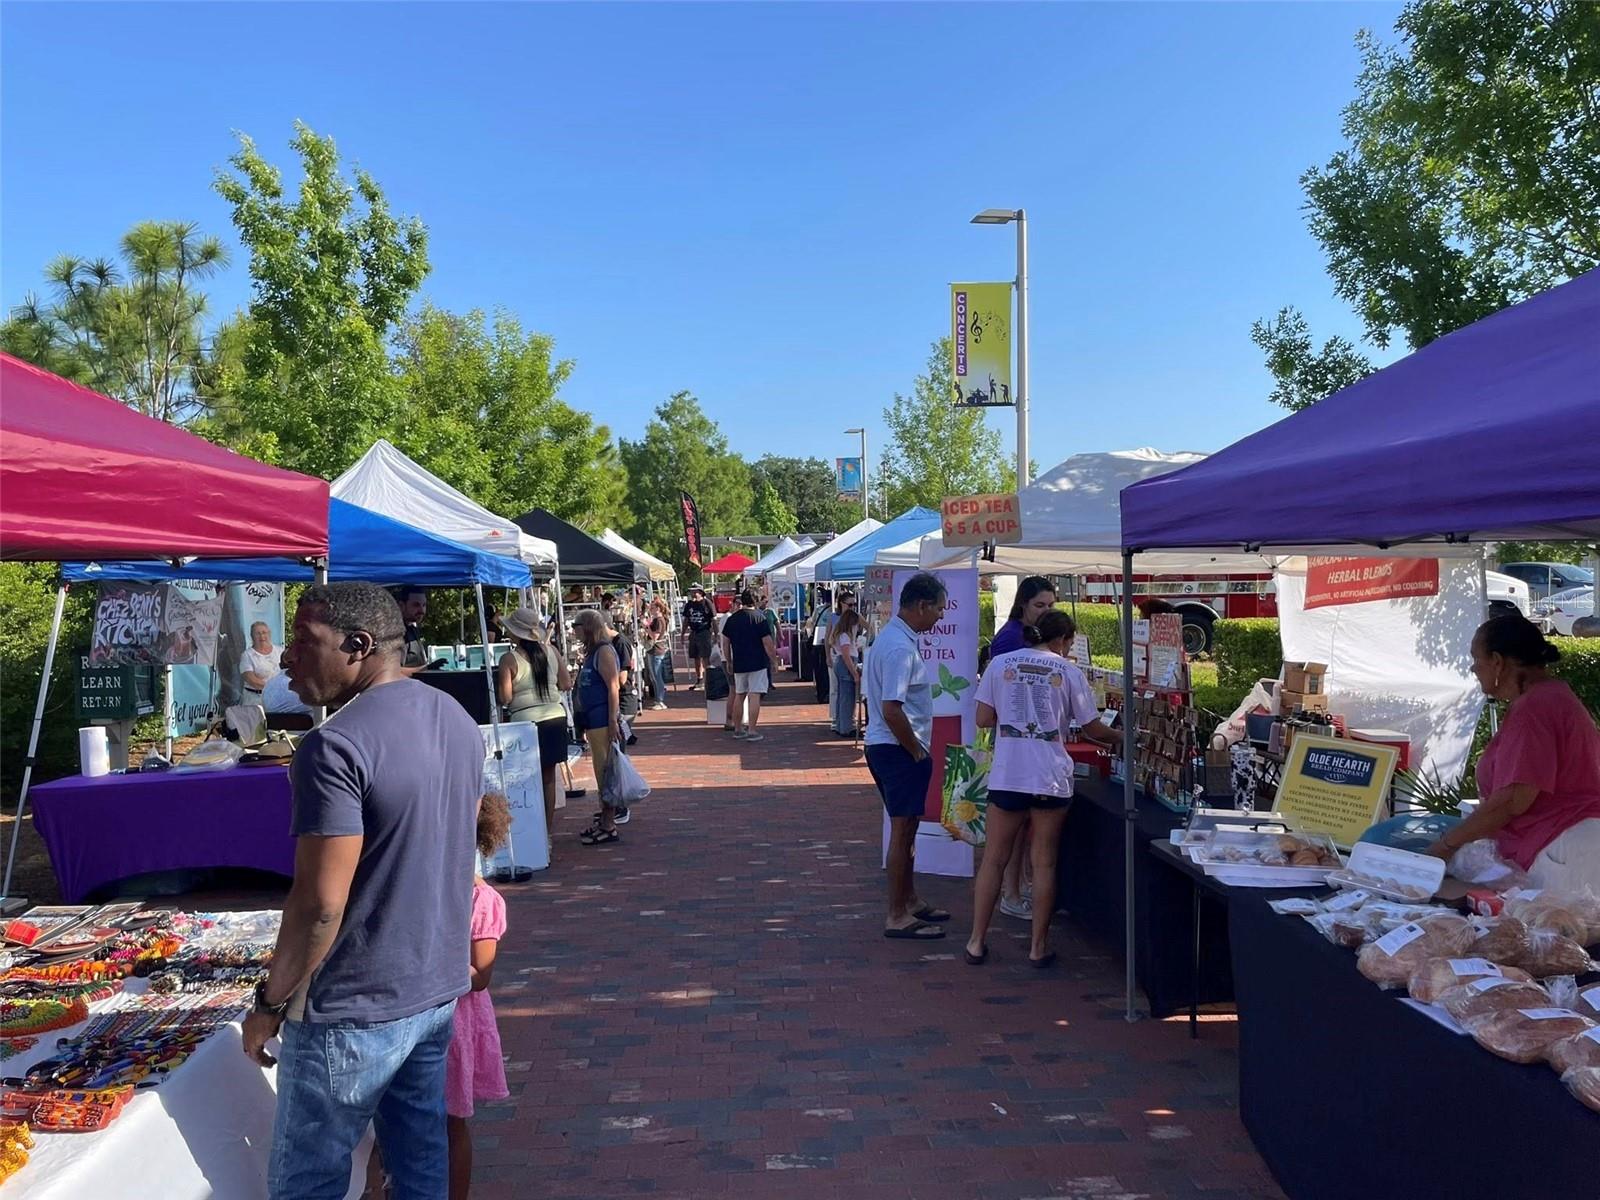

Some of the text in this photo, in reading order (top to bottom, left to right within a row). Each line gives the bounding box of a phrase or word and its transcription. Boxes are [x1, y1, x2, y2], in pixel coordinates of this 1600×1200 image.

[957, 294, 966, 375] CONCERTS
[943, 499, 1013, 515] ICED TEA
[957, 521, 966, 535] 5
[971, 520, 982, 535] A
[985, 519, 1018, 534] CUP
[1327, 562, 1394, 584] HERBAL BLENDS
[97, 598, 129, 620] CHEZ
[94, 617, 161, 649] KITCHEN
[935, 648, 955, 660] TEA
[81, 676, 122, 689] LEARN
[82, 696, 121, 708] RETURN
[171, 700, 187, 729] Get
[188, 703, 209, 727] your
[1309, 752, 1332, 766] OLDE
[1332, 756, 1371, 773] HEARTH
[1310, 763, 1365, 778] BREAD COMPANY
